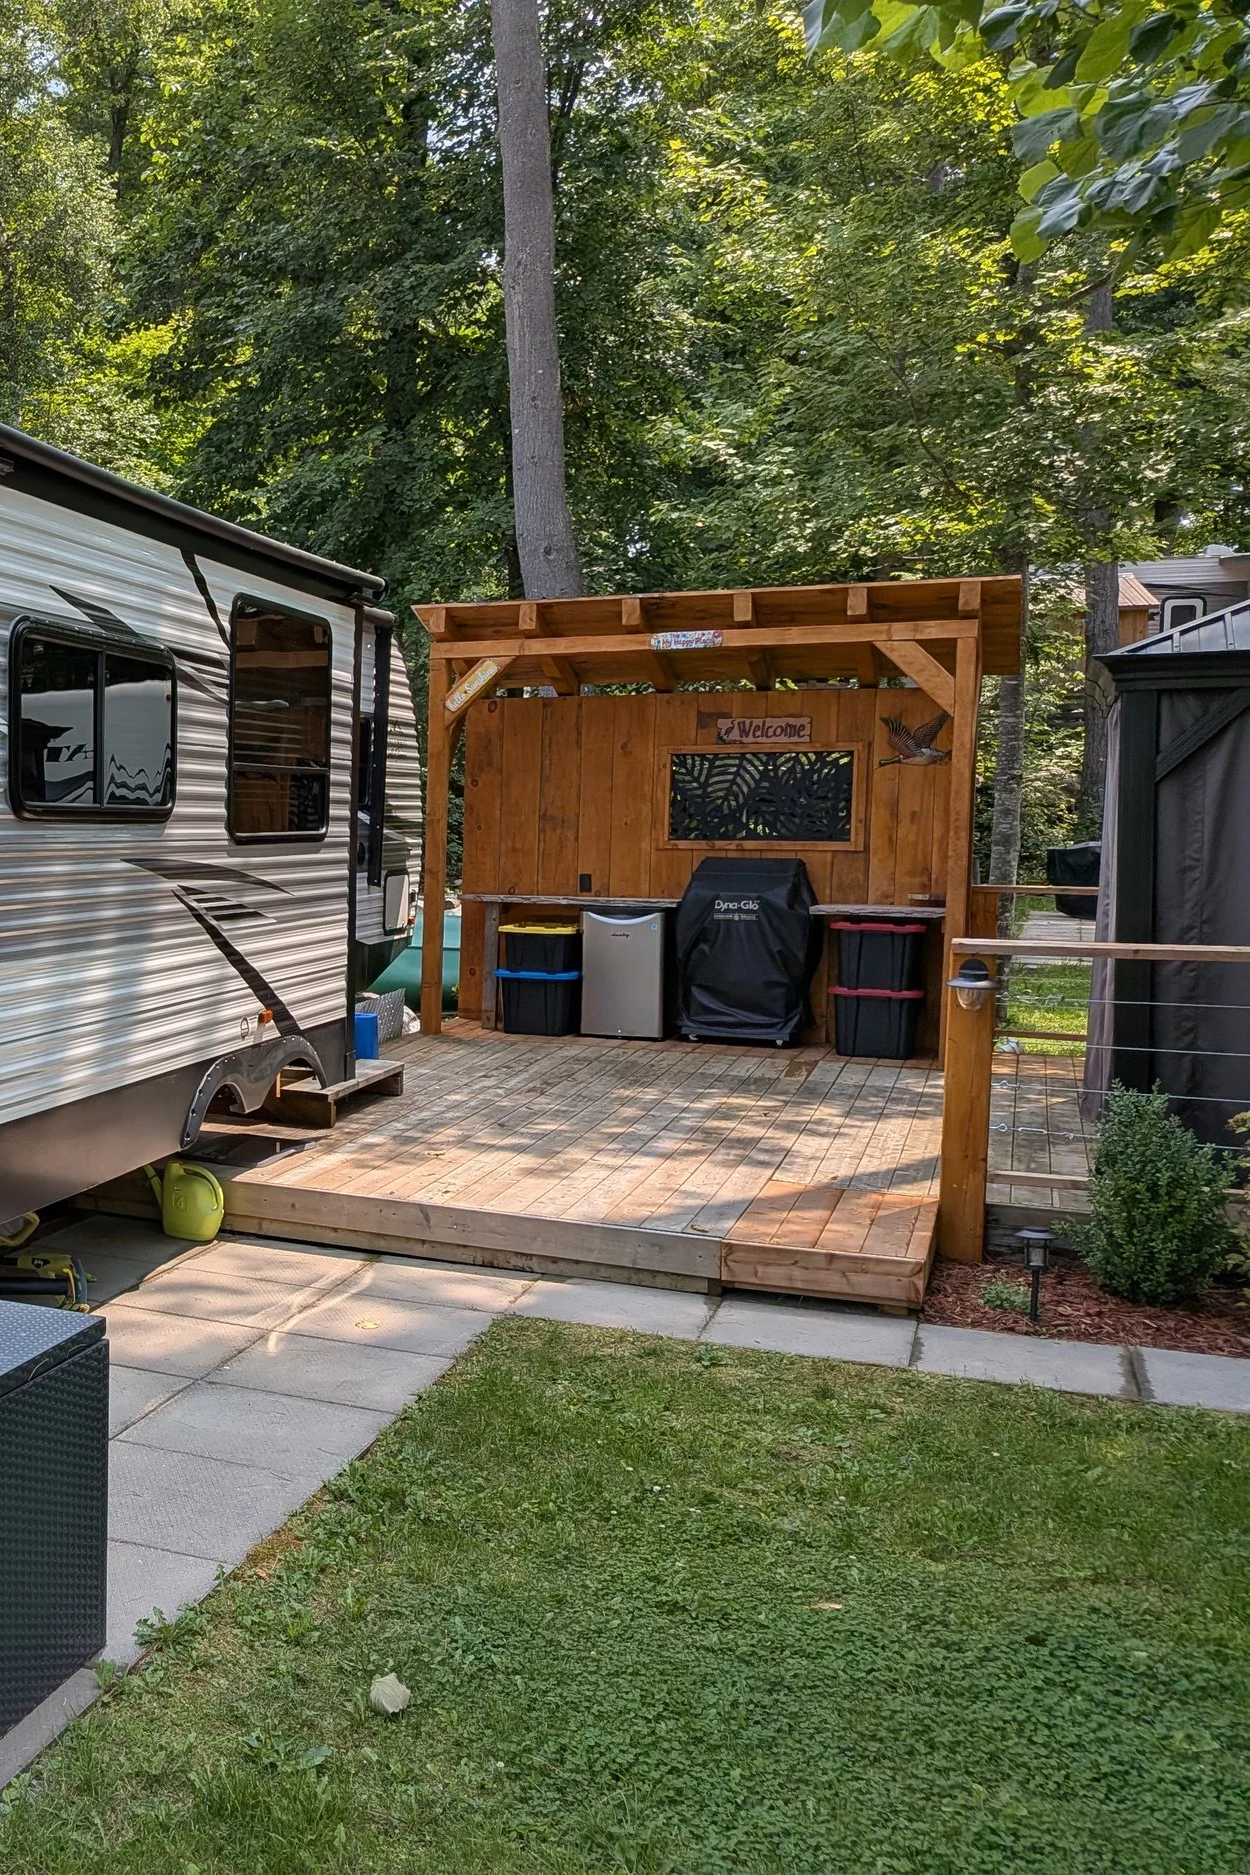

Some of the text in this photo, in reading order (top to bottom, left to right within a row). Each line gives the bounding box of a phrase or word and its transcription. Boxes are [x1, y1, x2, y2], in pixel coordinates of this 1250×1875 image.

[674, 639, 694, 648] Happy
[737, 719, 806, 739] Welcome
[714, 899, 759, 911] Dyna-Glo
